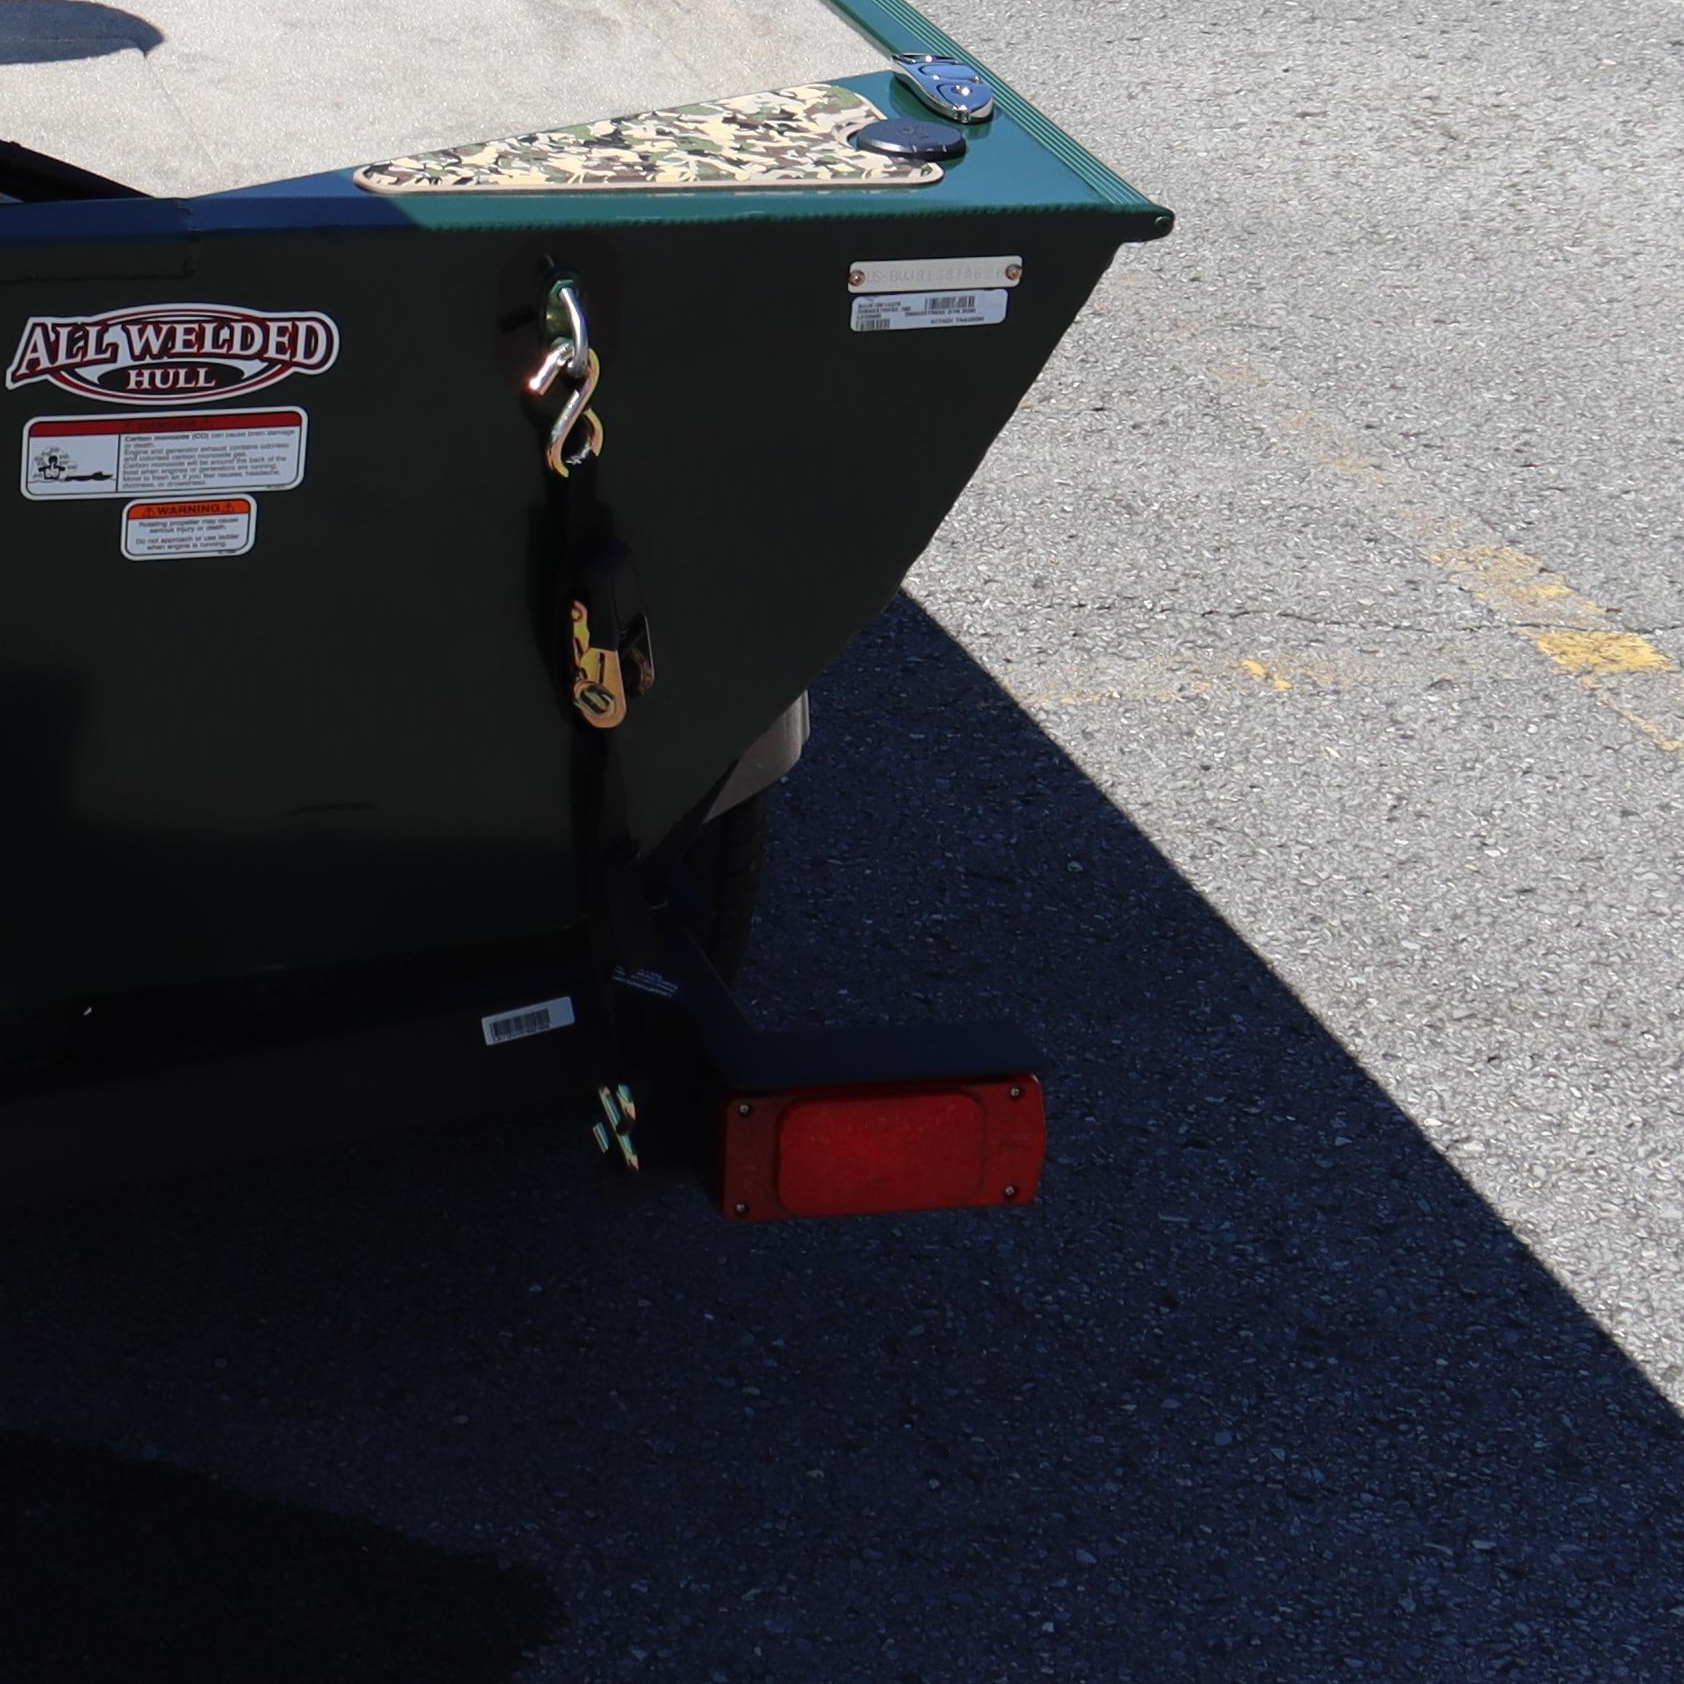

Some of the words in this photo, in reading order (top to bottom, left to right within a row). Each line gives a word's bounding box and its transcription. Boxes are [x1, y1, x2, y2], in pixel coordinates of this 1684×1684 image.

[15, 322, 120, 374] ALL
[125, 319, 329, 368] WELDED
[126, 366, 217, 390] HULL
[156, 503, 220, 516] WARNING
